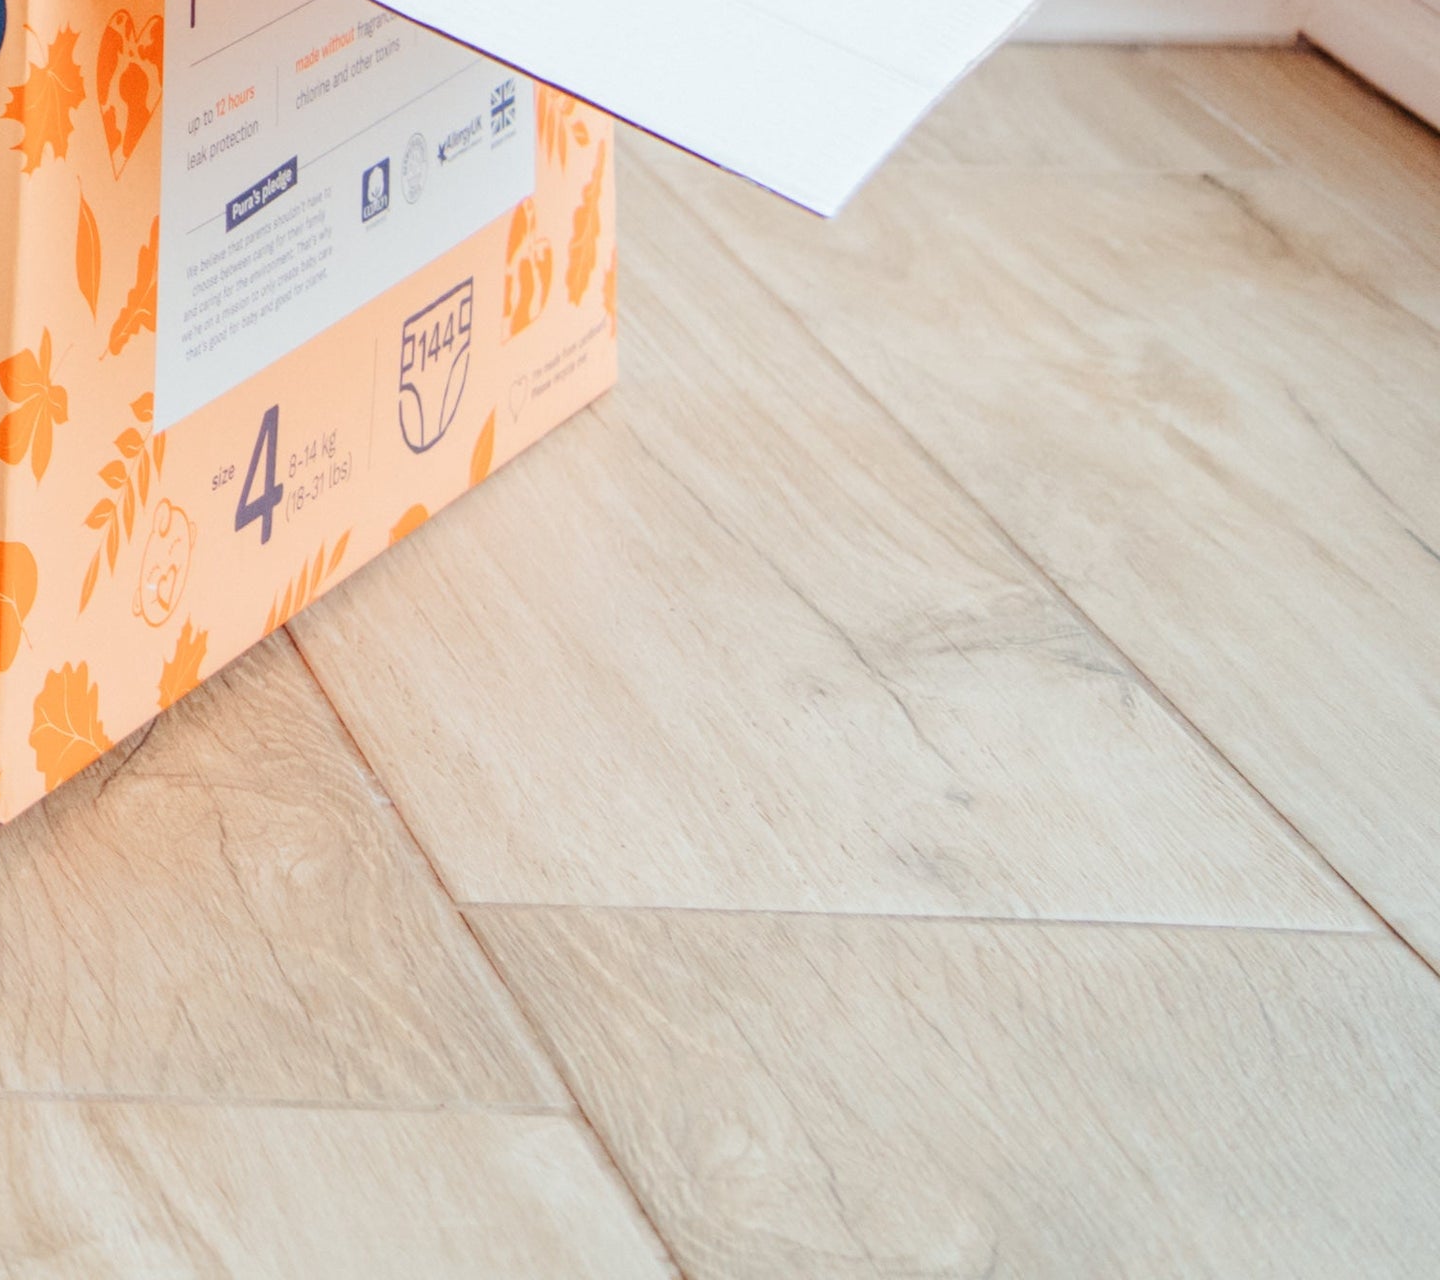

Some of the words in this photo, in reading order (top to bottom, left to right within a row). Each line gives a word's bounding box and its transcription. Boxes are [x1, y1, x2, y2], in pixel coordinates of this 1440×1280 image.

[295, 45, 320, 74] made
[321, 28, 356, 62] without
[295, 78, 331, 110] chlorine
[333, 68, 349, 89] and
[351, 54, 374, 78] other
[375, 37, 402, 62] toxins
[188, 116, 200, 135] up
[203, 109, 213, 126] to
[216, 98, 226, 116] 12
[227, 87, 255, 109] hours
[187, 145, 207, 171] leak
[209, 120, 258, 158] protection
[232, 189, 261, 220] Pura's
[261, 168, 292, 204] pledge
[418, 312, 454, 372] 144
[211, 464, 235, 491] size
[233, 403, 284, 545] 4
[288, 439, 317, 478] 8-14
[321, 431, 336, 459] kg
[285, 472, 324, 522] (18-31
[328, 451, 352, 488] lbs)
